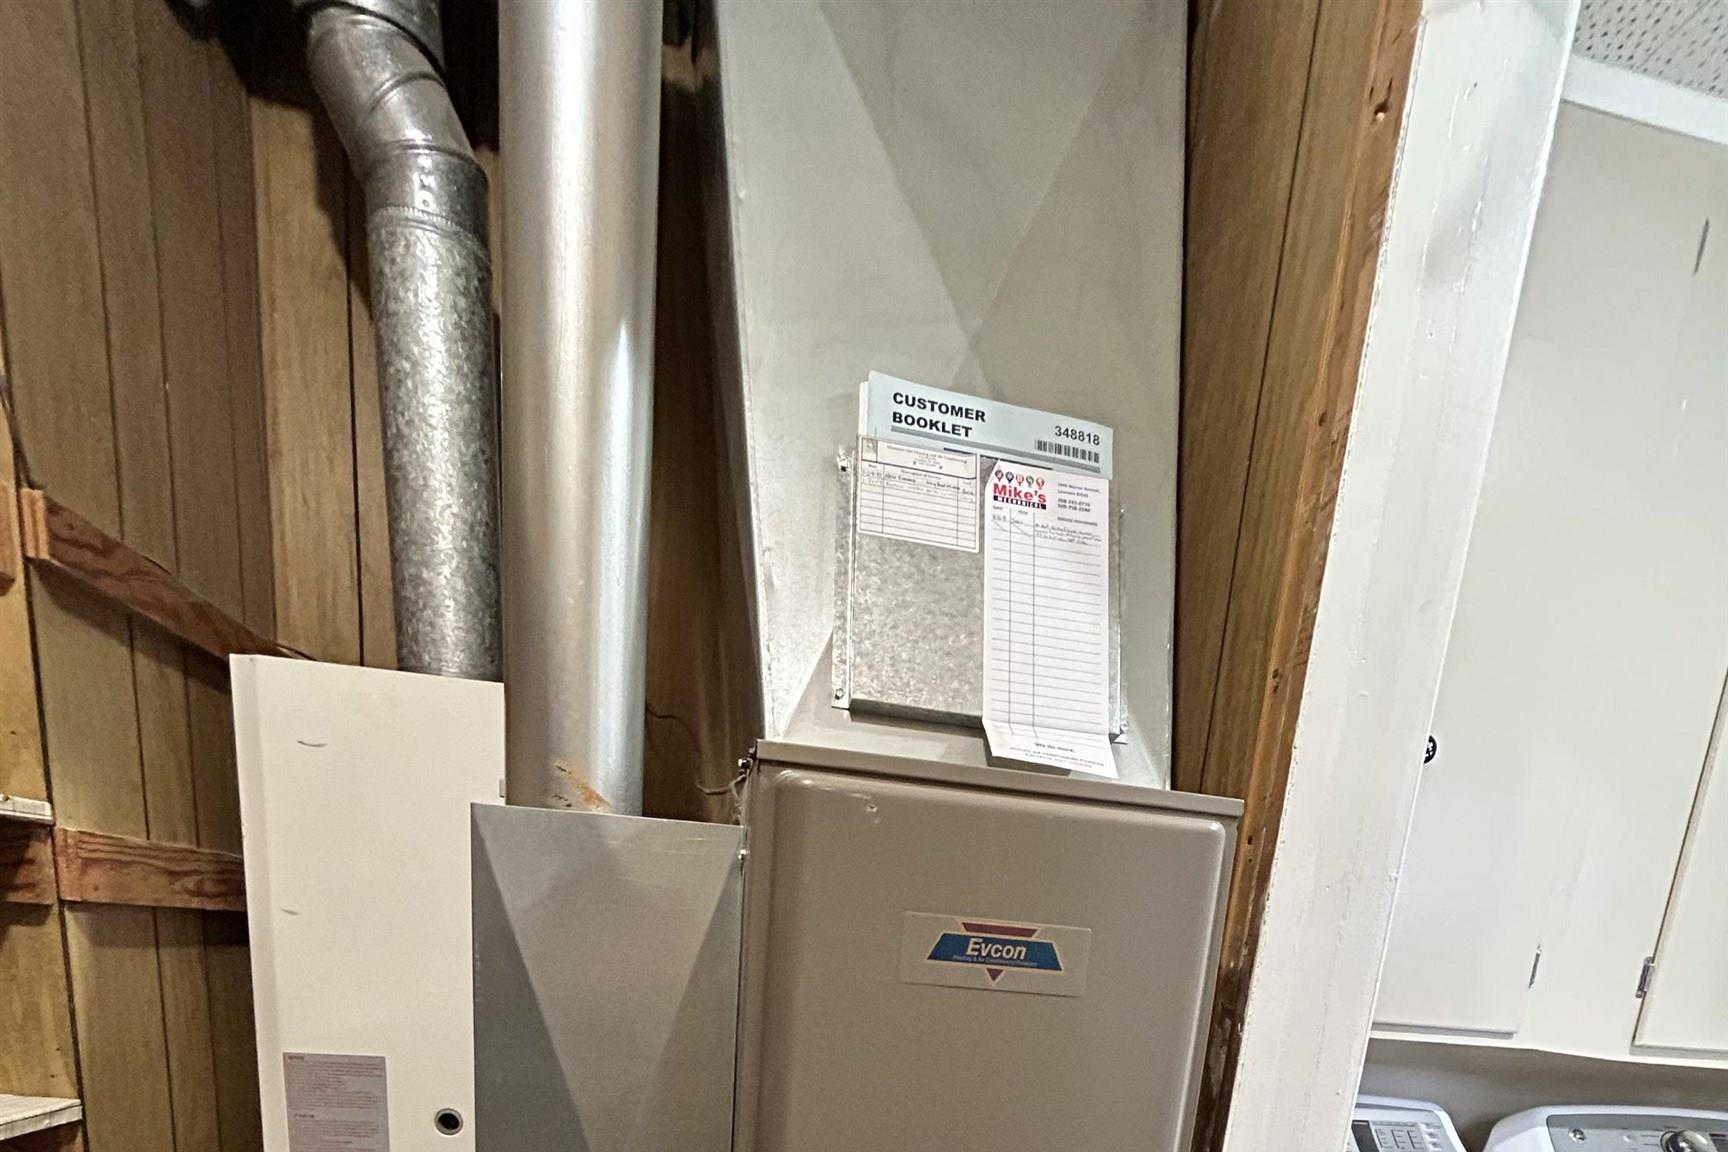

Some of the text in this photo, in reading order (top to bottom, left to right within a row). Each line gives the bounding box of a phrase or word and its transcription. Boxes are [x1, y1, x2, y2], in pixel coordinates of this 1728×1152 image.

[892, 392, 986, 423] CUSTOMER
[892, 411, 973, 439] BOOKLET
[1054, 425, 1101, 446] 348818
[993, 483, 1047, 504] Mike's
[965, 937, 1027, 960] Evcon
